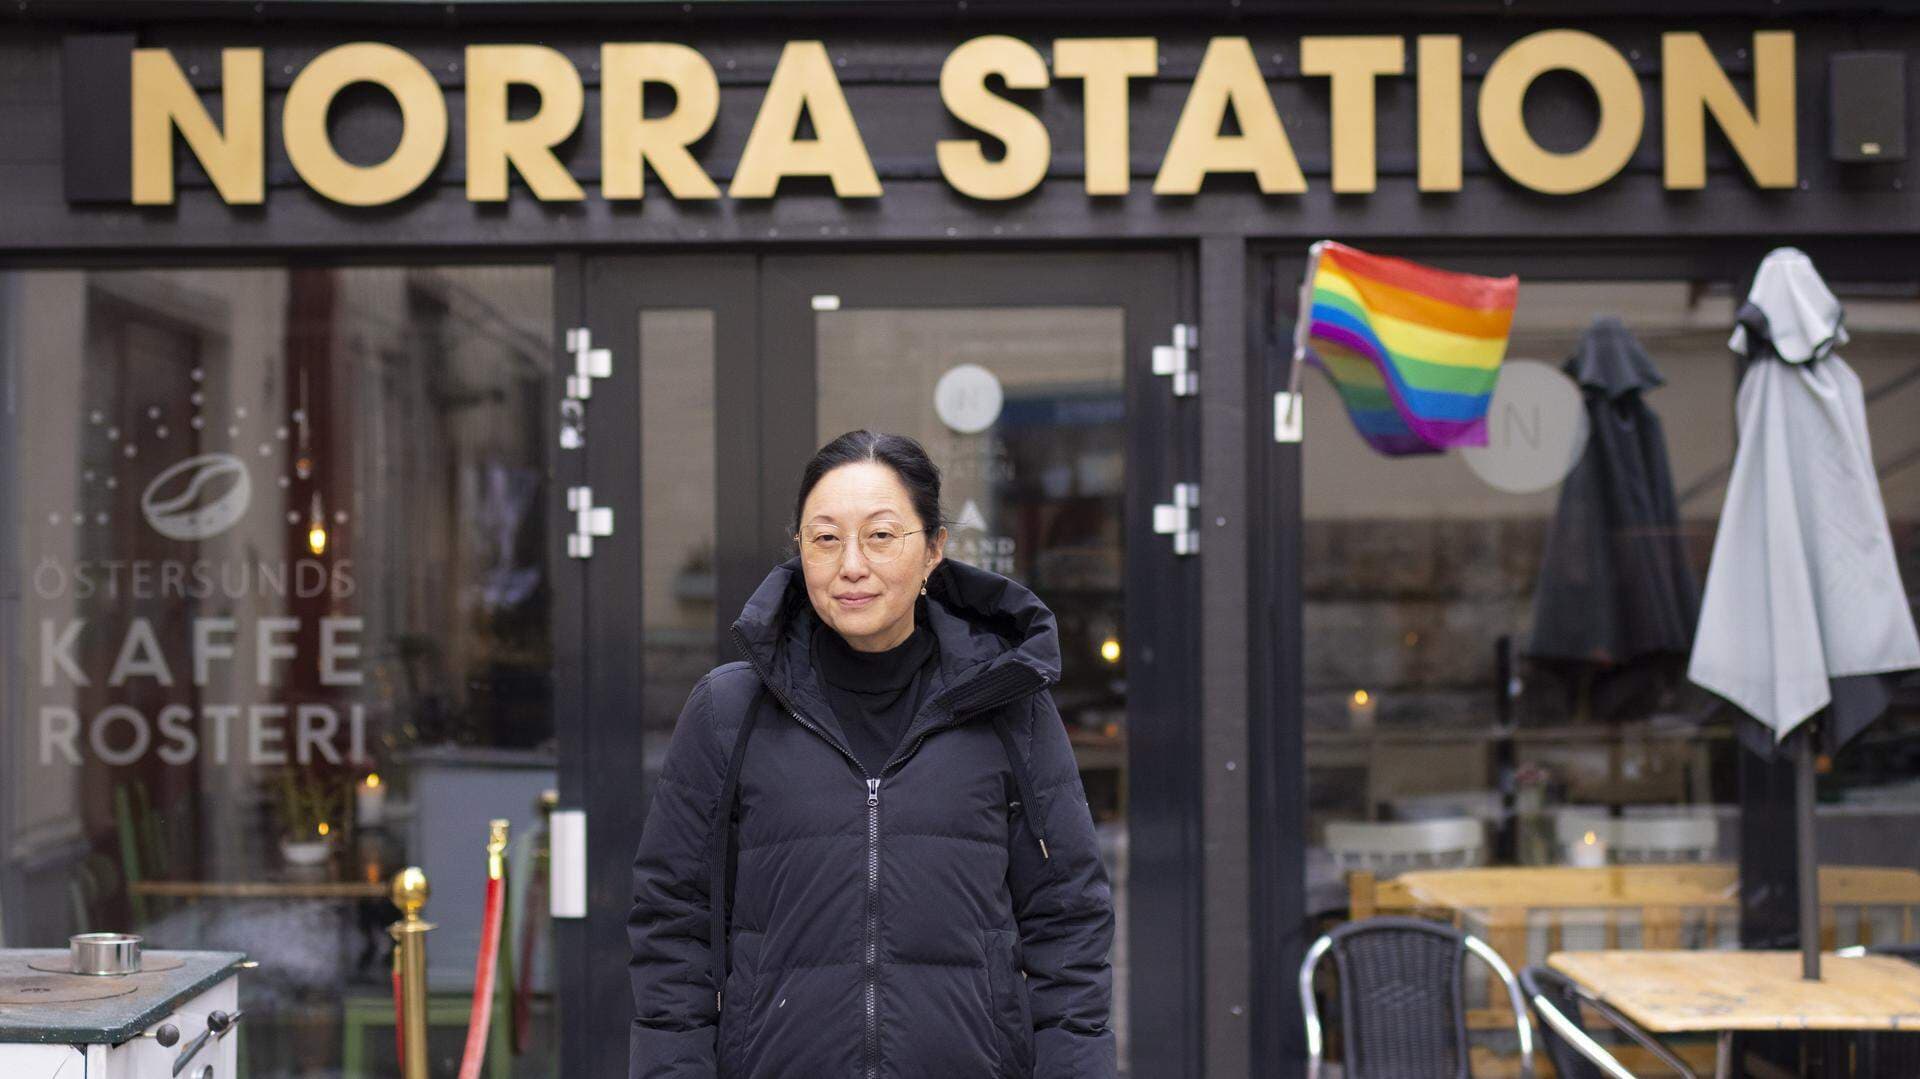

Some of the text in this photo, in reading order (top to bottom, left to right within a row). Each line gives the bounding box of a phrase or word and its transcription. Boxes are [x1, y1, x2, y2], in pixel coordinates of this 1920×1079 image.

[132, 30, 1797, 206] NORRA STATION
[1502, 401, 1541, 449] N
[33, 558, 357, 600] ÖSTERSUNDS
[40, 617, 364, 688] KAFFE
[40, 704, 366, 766] ROSTERI
